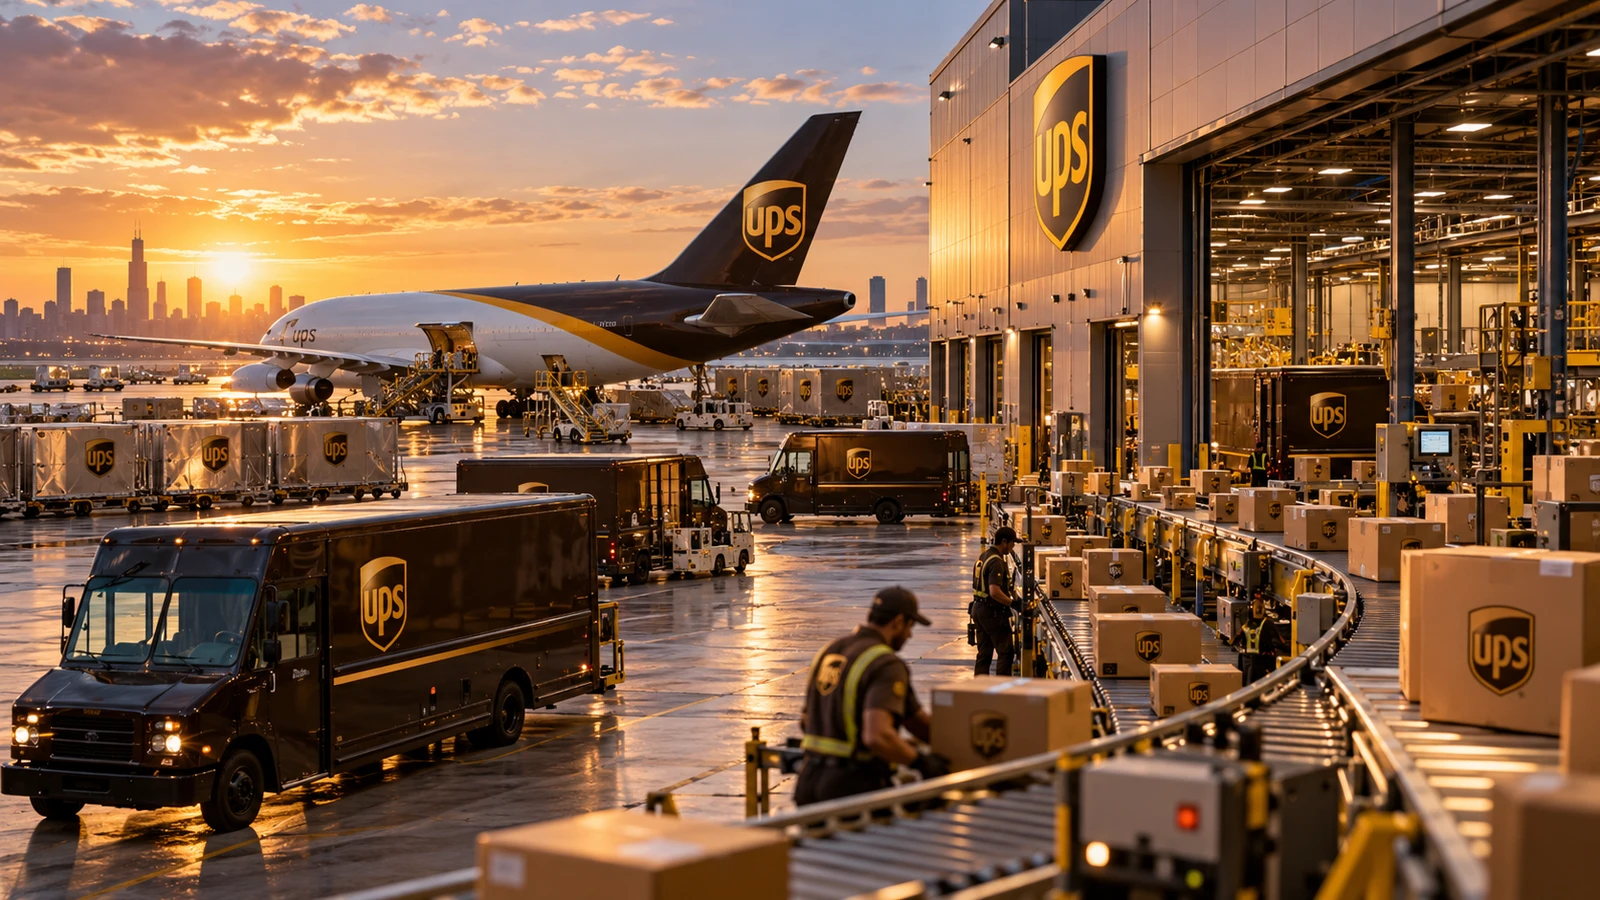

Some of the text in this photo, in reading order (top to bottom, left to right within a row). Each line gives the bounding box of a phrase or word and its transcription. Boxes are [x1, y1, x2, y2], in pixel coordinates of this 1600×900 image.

[1036, 110, 1088, 217] ups
[747, 205, 801, 248] ups
[293, 329, 317, 348] ups
[837, 384, 853, 399] ups
[1312, 406, 1344, 431] ups
[87, 450, 114, 472] ups
[204, 447, 227, 468] ups
[326, 442, 346, 461] ups
[849, 457, 870, 474] ups
[364, 584, 404, 636] ups
[1138, 640, 1160, 658] ups
[1474, 634, 1528, 679] ups
[1190, 690, 1208, 704] ups
